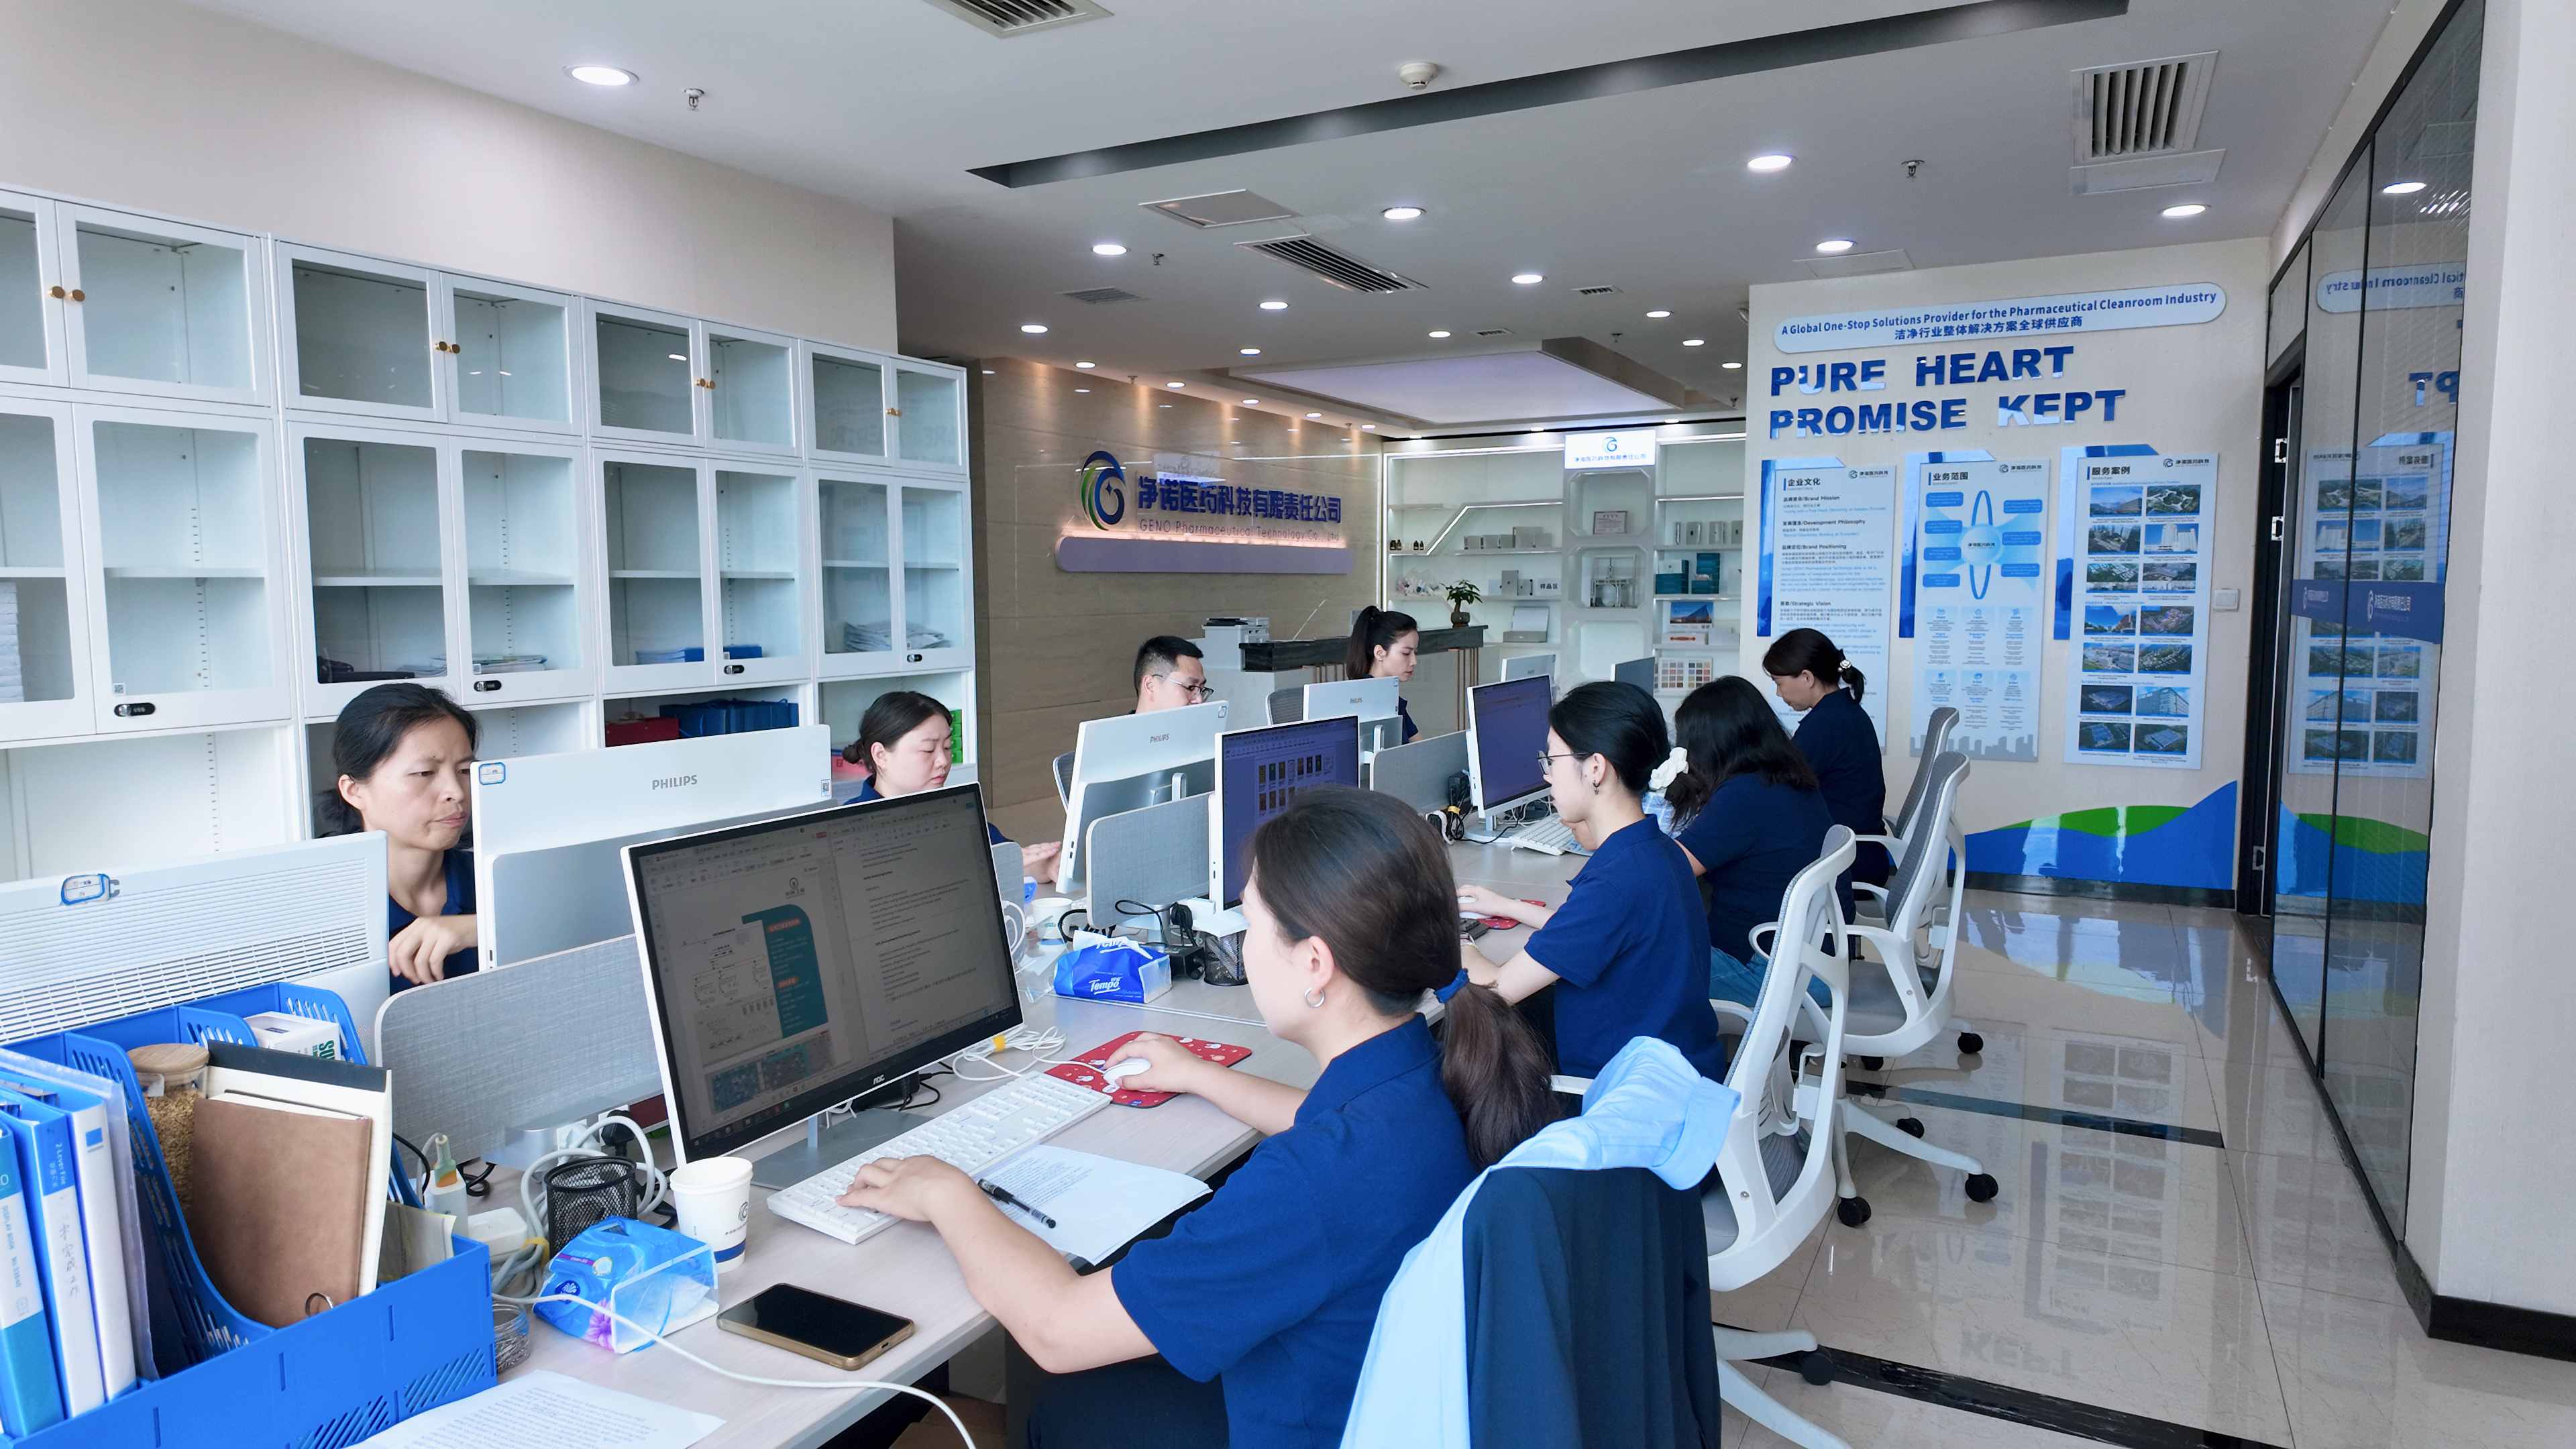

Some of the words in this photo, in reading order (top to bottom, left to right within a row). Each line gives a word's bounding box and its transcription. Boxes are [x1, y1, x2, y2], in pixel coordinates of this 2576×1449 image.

[1782, 326, 1788, 335] A
[1790, 323, 1822, 335] Global
[1823, 319, 1870, 331] One-Stop
[1872, 315, 1921, 327] Solutions
[1923, 311, 1970, 323] Provider
[1972, 310, 1988, 320] for
[1989, 307, 2007, 318] the
[2009, 301, 2097, 317] Pharmaceutical
[2099, 296, 2163, 310] Cleanroom
[2165, 292, 2217, 305] Industry
[1894, 316, 2083, 341] 洁净行业整体解决方案全球供应商
[1770, 359, 1887, 397] PURE
[1915, 345, 2075, 387] HEART
[1769, 398, 1968, 440] PROMISE
[1997, 389, 2127, 428] KEPT
[1788, 477, 1821, 487] 企业文化
[1932, 472, 1969, 481] 业务范围
[2091, 466, 2131, 476] 服务案例
[1138, 476, 1342, 523] 净诺医药科技有限责任公司
[1140, 519, 1171, 533] GENO
[1256, 526, 1305, 542] Technology
[651, 774, 698, 790] PHILIPS
[1089, 979, 1120, 992] Tempo
